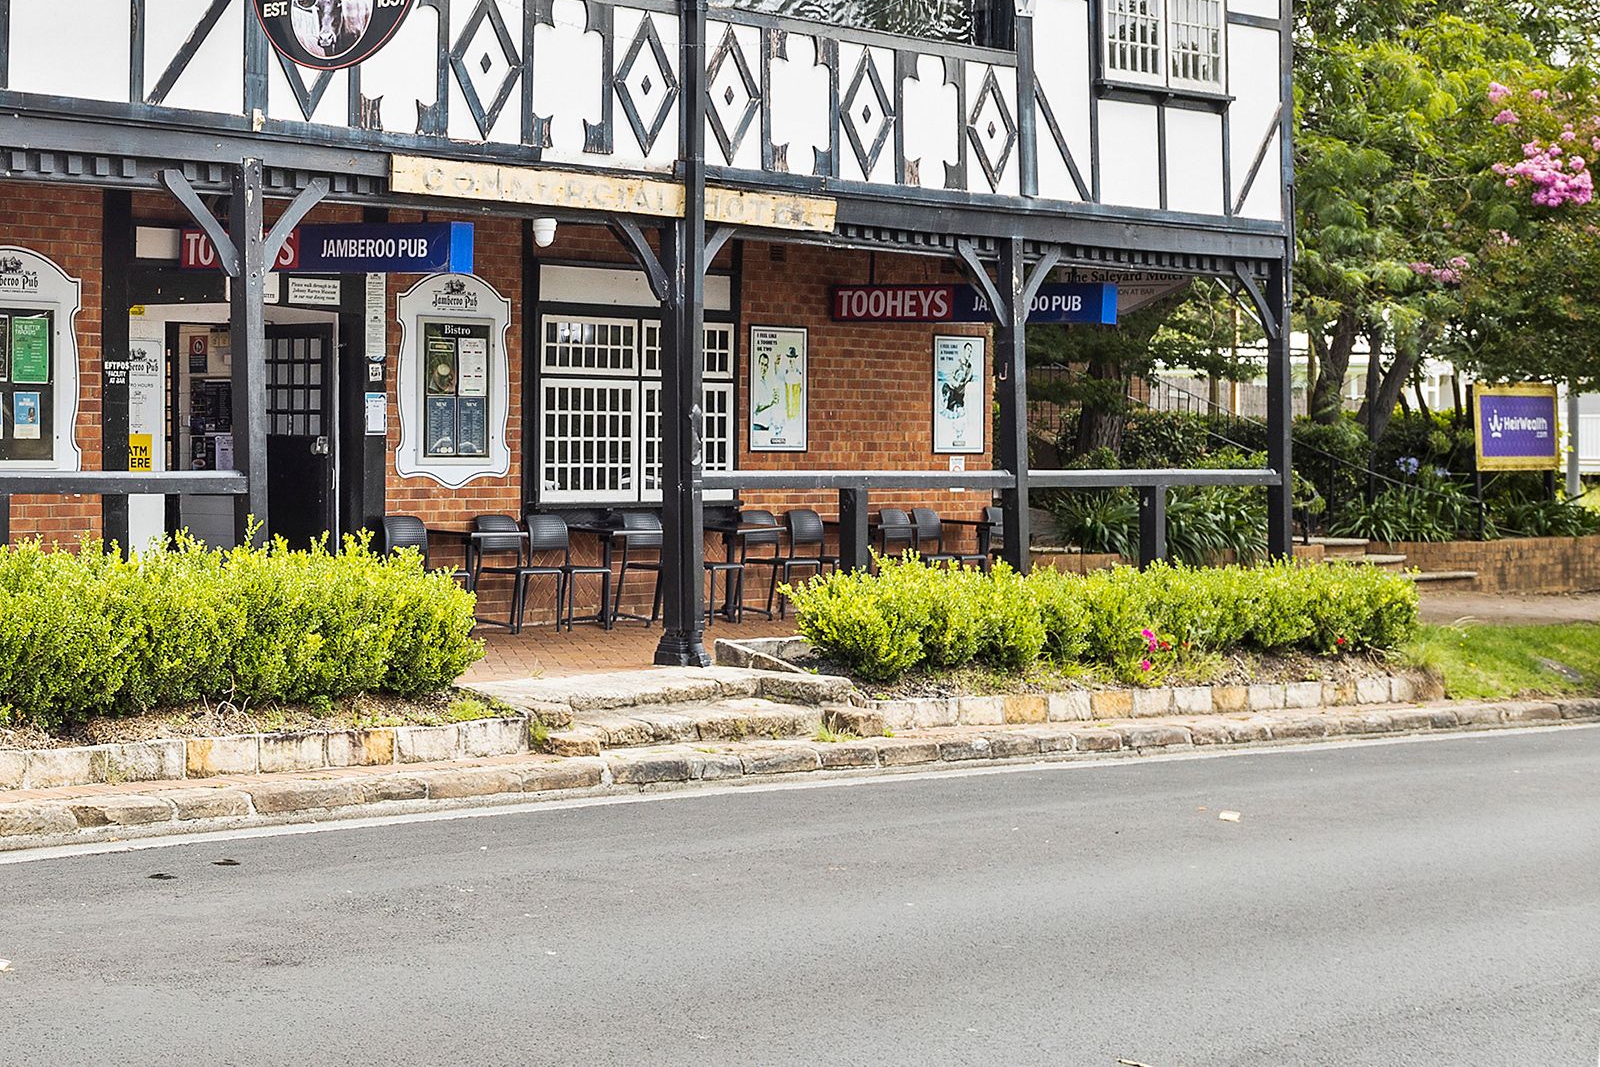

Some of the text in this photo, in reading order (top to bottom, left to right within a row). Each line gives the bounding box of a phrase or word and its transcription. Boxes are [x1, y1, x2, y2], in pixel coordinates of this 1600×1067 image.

[263, 1, 288, 18] EST.
[321, 238, 428, 258] JAMBEROO PUB
[21, 274, 39, 290] Pub
[1065, 271, 1088, 282] The
[1091, 271, 1145, 283] Saleyard
[838, 289, 948, 318] TOOHEYS
[1052, 295, 1082, 312] PUB
[444, 324, 471, 335] Bistro
[104, 361, 130, 371] EFTPOS
[1503, 416, 1548, 430] HeirWealth
[130, 457, 151, 468] ERE
